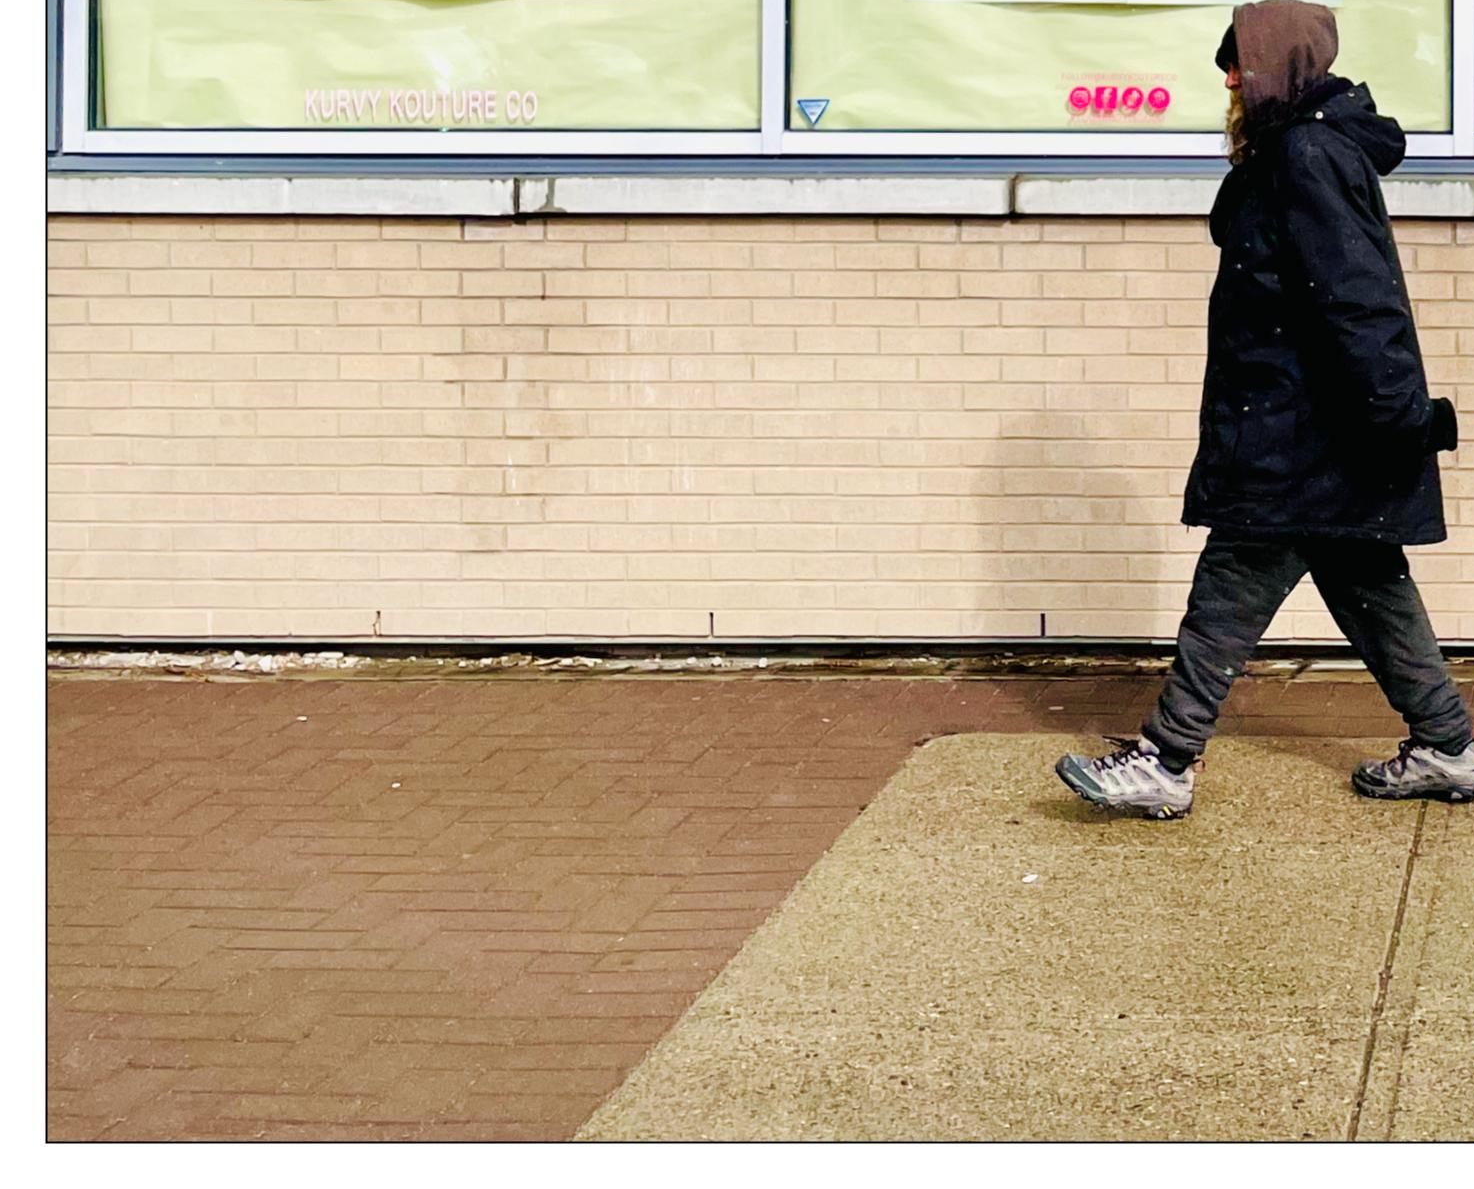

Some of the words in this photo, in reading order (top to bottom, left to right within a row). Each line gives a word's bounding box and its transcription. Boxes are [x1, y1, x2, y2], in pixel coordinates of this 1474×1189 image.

[304, 89, 381, 120] KURVY
[389, 89, 498, 121] KOUTURE
[505, 90, 539, 121] CO
